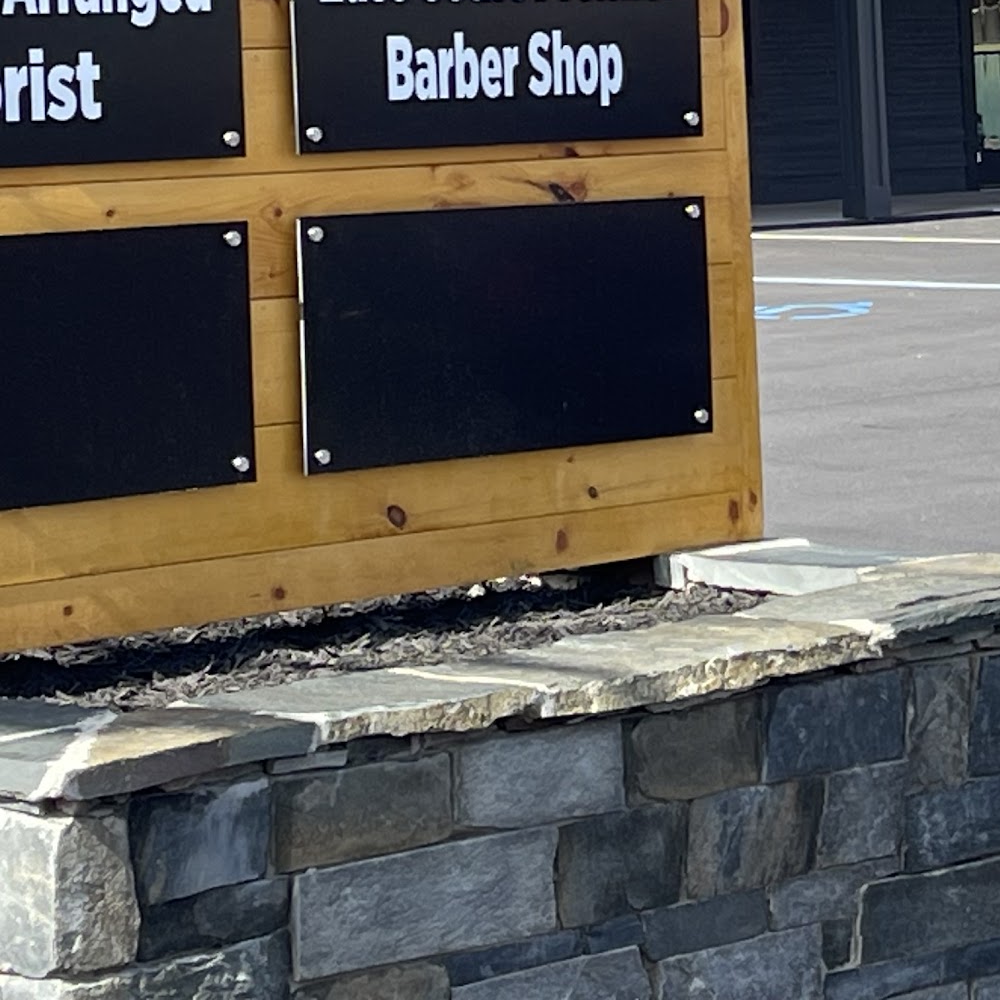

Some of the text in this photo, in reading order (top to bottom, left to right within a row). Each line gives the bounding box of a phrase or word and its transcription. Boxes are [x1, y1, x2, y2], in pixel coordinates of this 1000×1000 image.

[0, 48, 101, 121] rist
[387, 30, 622, 106] Barber Shop
